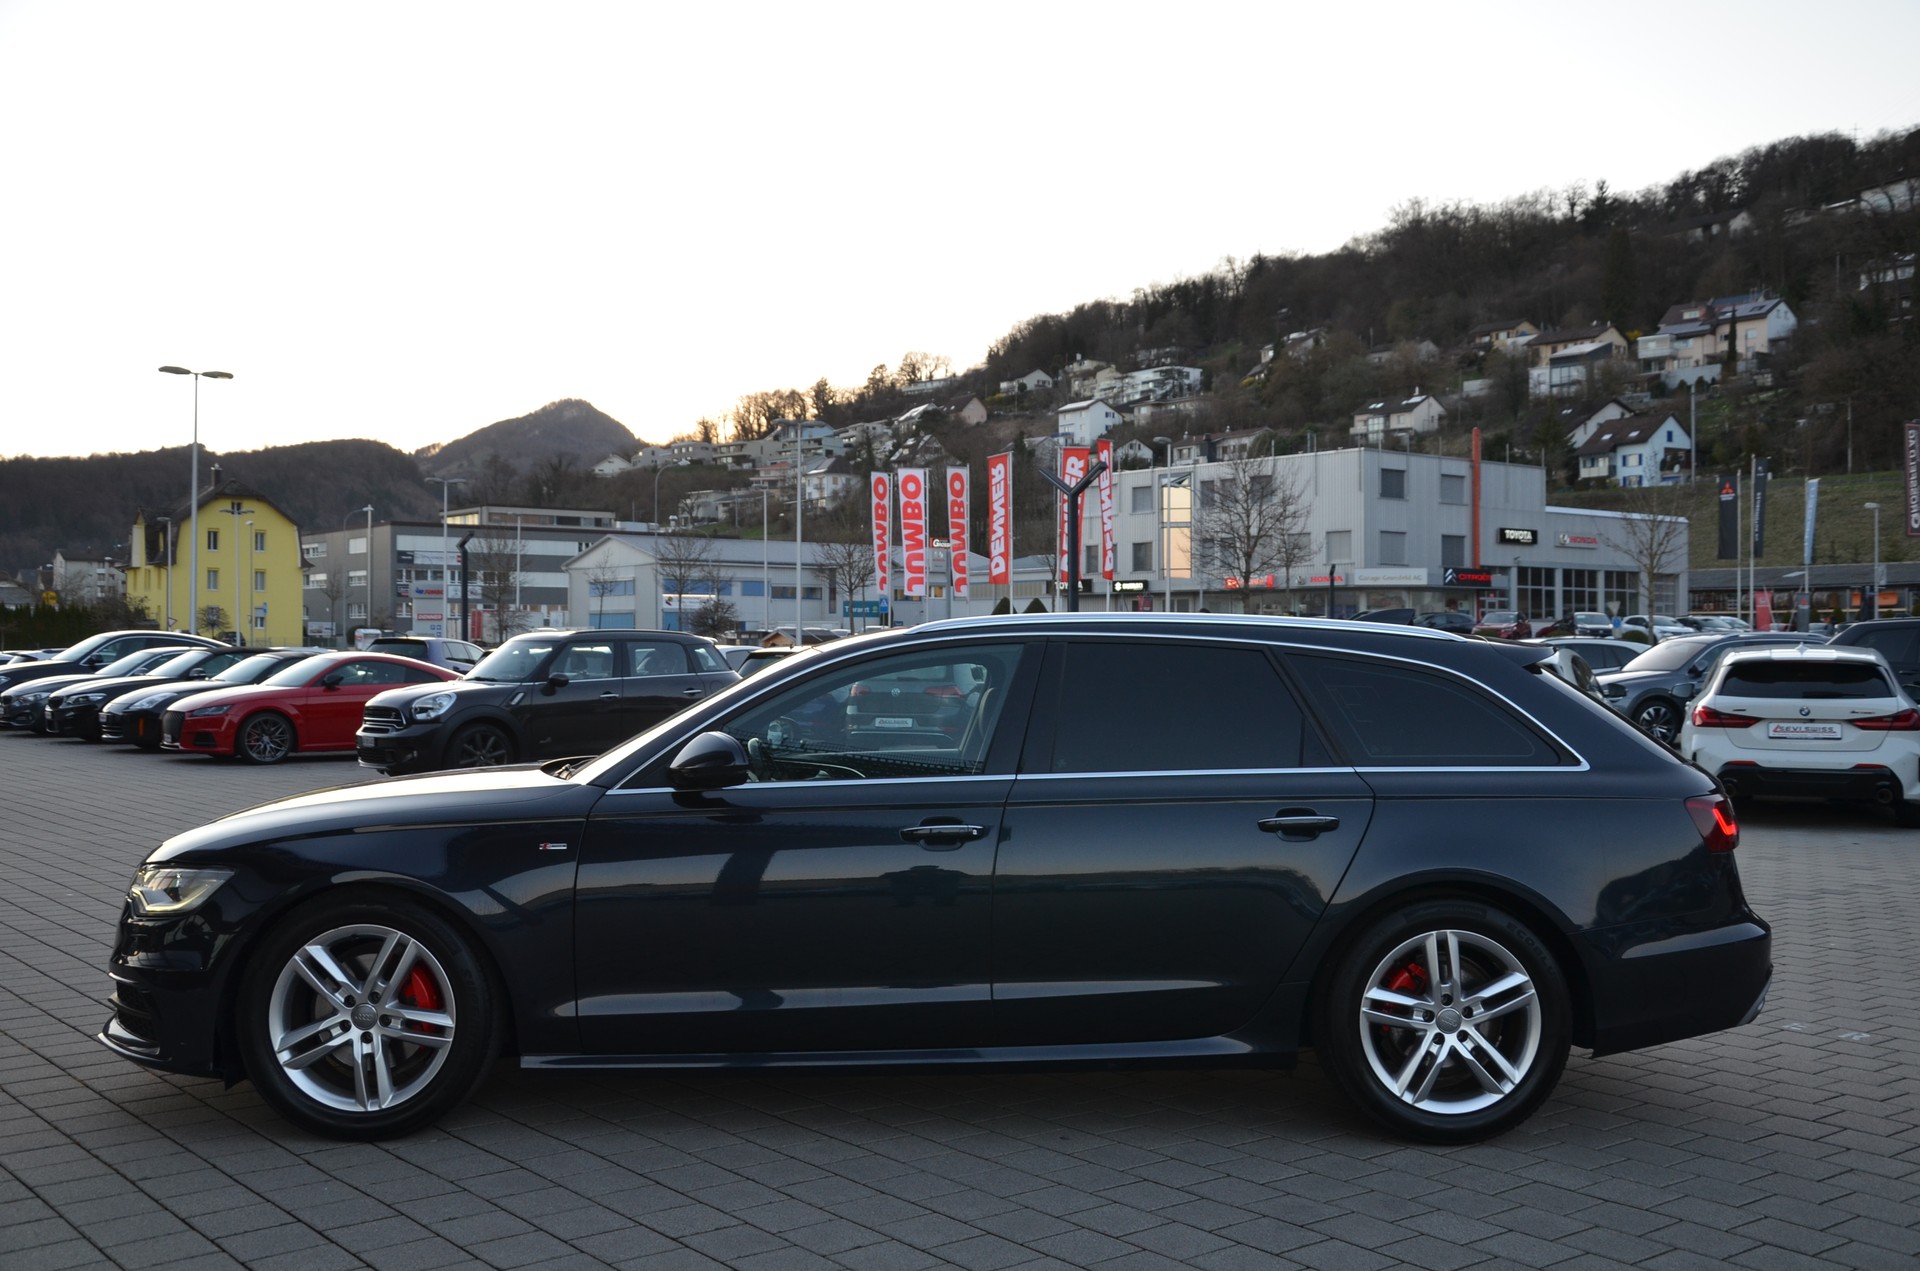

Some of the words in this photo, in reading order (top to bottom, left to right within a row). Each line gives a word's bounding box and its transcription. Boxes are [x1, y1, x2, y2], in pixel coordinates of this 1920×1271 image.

[873, 476, 888, 591] JUMBO
[901, 474, 925, 592] JUMBO
[949, 472, 968, 593] JUMBO
[990, 463, 1006, 576] DENNER
[1504, 529, 1533, 540] TOYOTA
[1568, 535, 1598, 544] HONDA
[1054, 580, 1083, 590] TOYA
